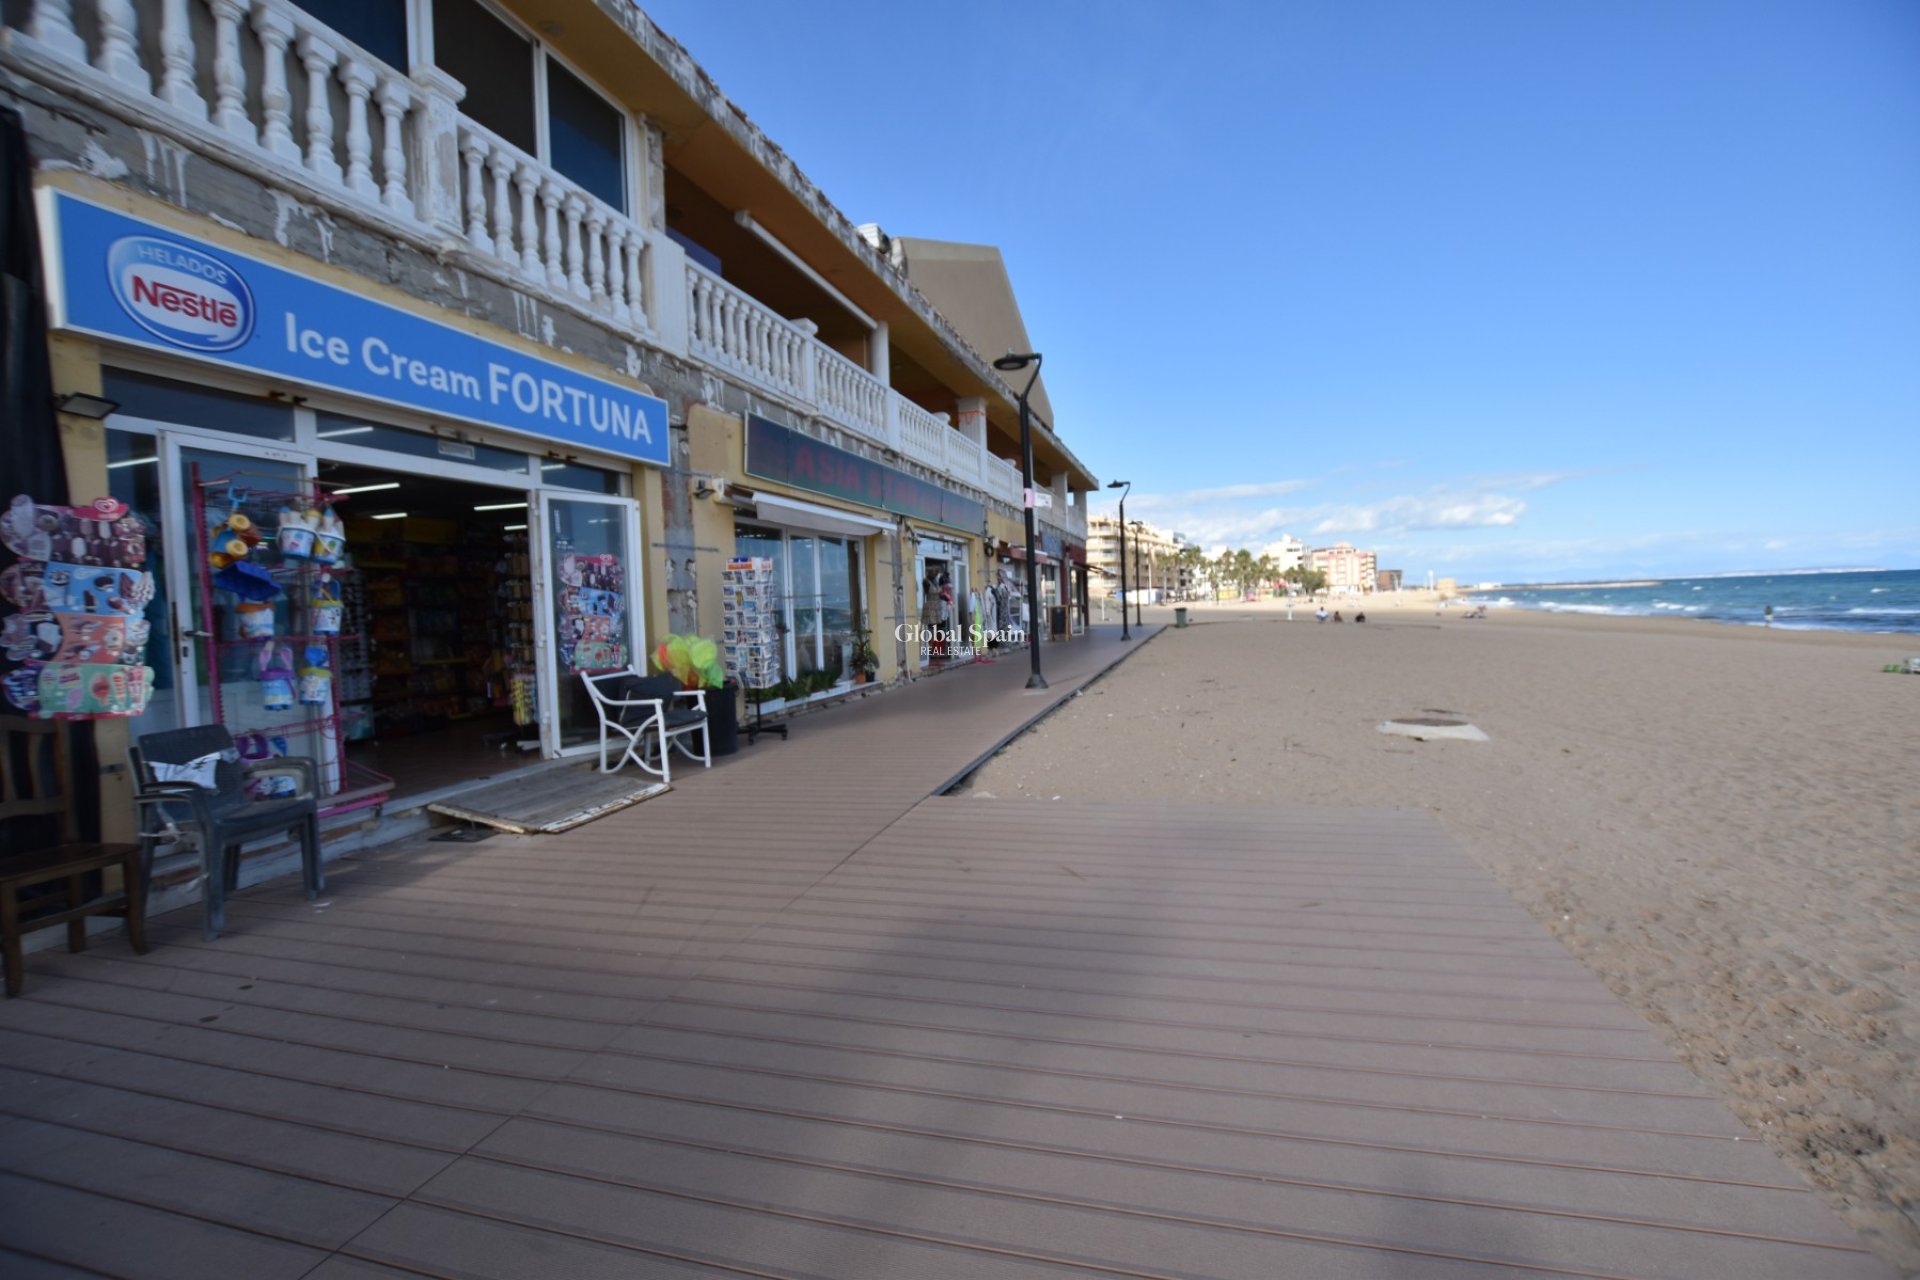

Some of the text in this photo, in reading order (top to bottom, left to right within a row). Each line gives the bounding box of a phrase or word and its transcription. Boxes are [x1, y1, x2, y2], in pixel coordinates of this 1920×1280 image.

[136, 244, 228, 285] HELADOS
[285, 311, 653, 445] Ice Cream FORTUNA
[794, 444, 862, 494] ASIA
